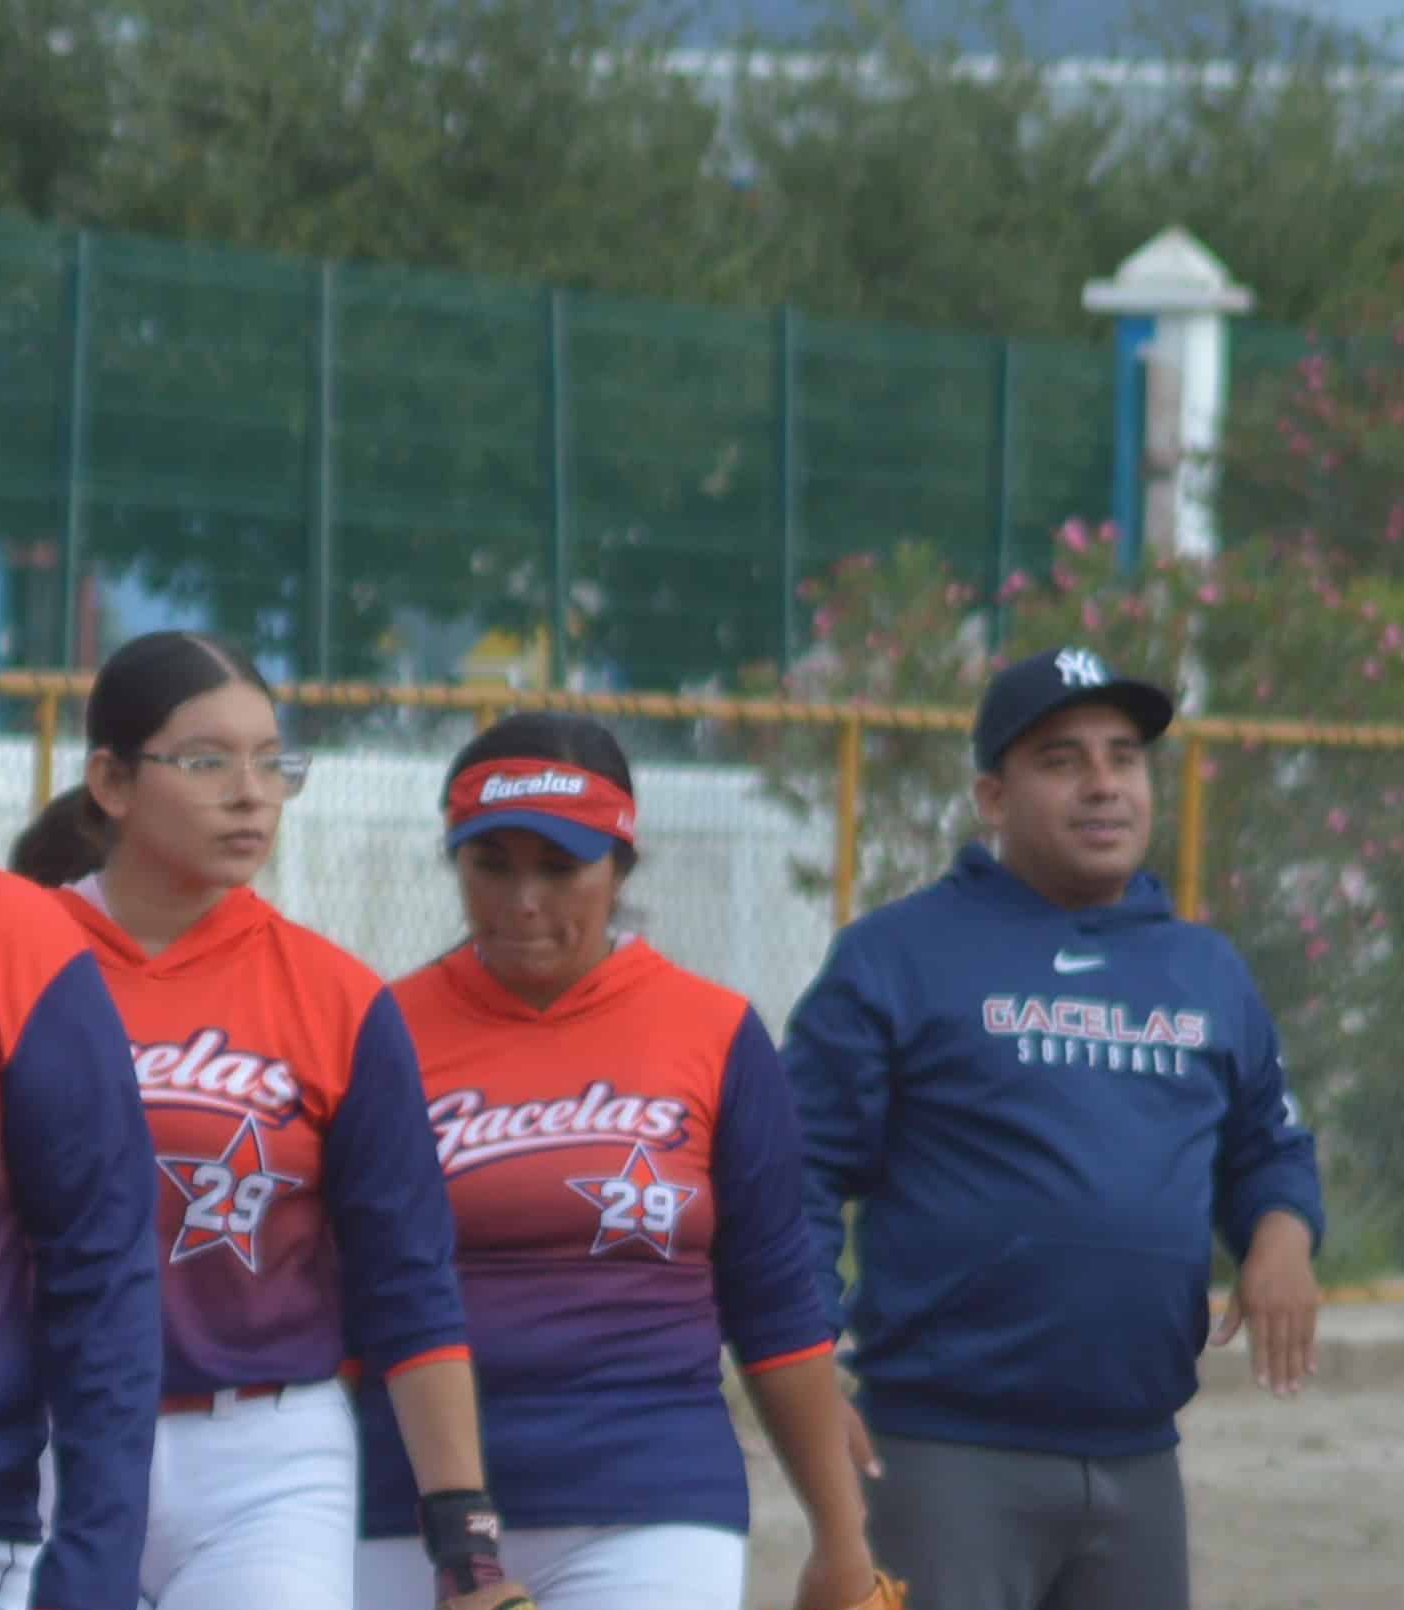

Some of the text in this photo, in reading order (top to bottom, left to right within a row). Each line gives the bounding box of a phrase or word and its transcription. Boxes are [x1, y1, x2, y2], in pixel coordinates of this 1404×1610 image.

[480, 769, 586, 804] Gacelas
[983, 997, 1205, 1048] GACELAS
[1018, 1037, 1185, 1075] SOFTBALL
[427, 1081, 685, 1171] Gacelas
[184, 1164, 275, 1233] 29
[600, 1181, 675, 1232] 29
